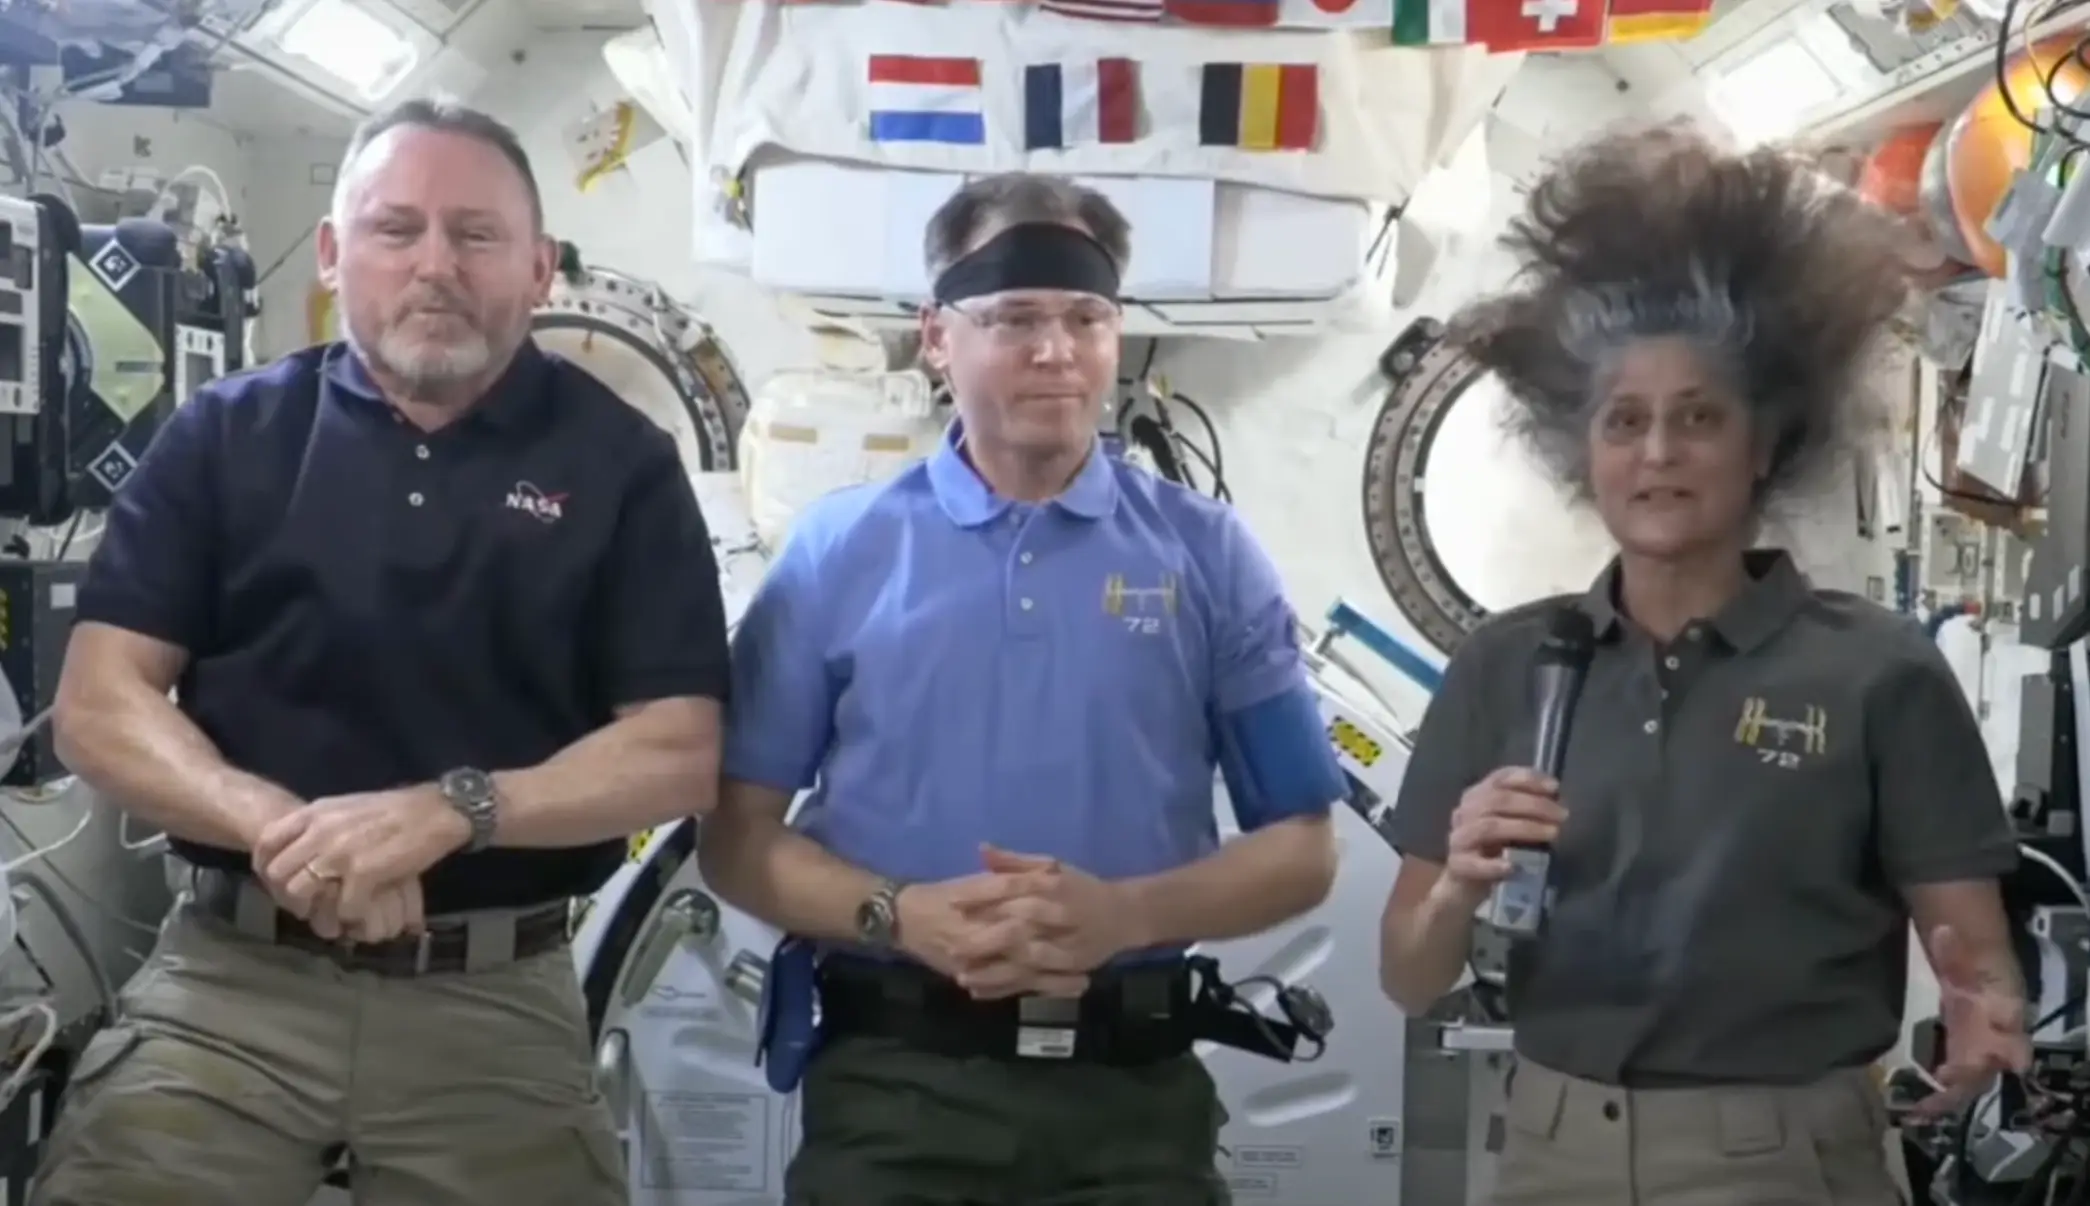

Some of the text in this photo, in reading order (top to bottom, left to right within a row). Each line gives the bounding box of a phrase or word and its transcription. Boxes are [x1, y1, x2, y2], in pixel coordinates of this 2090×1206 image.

[505, 493, 562, 518] NASA
[1122, 616, 1160, 633] 72
[1757, 748, 1800, 770] 72
